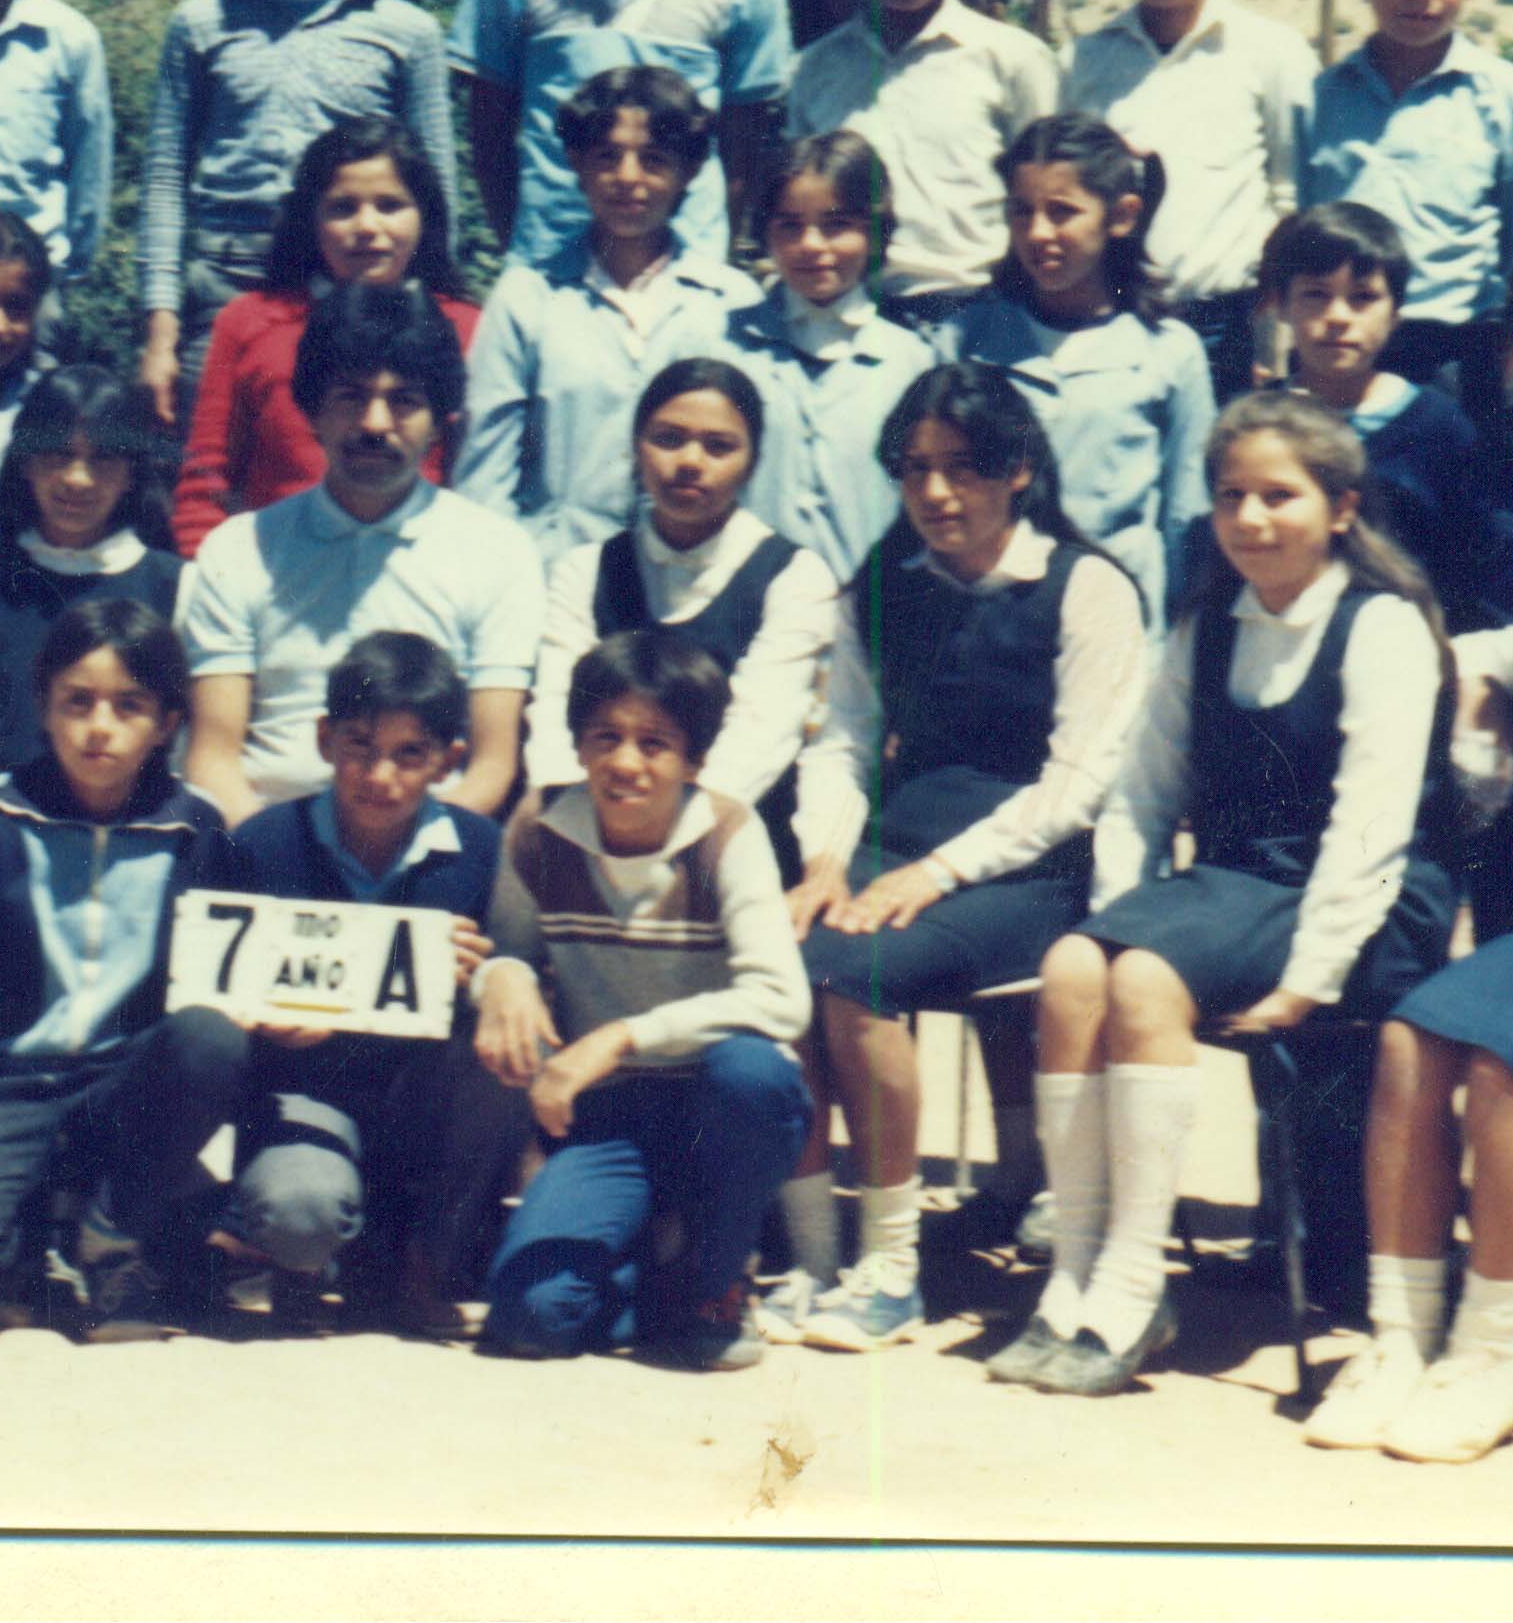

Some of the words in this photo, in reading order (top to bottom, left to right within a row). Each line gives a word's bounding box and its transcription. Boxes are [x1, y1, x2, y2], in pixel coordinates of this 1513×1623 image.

[207, 903, 255, 994] 7
[274, 953, 346, 991] AÑO
[374, 919, 419, 1013] A
